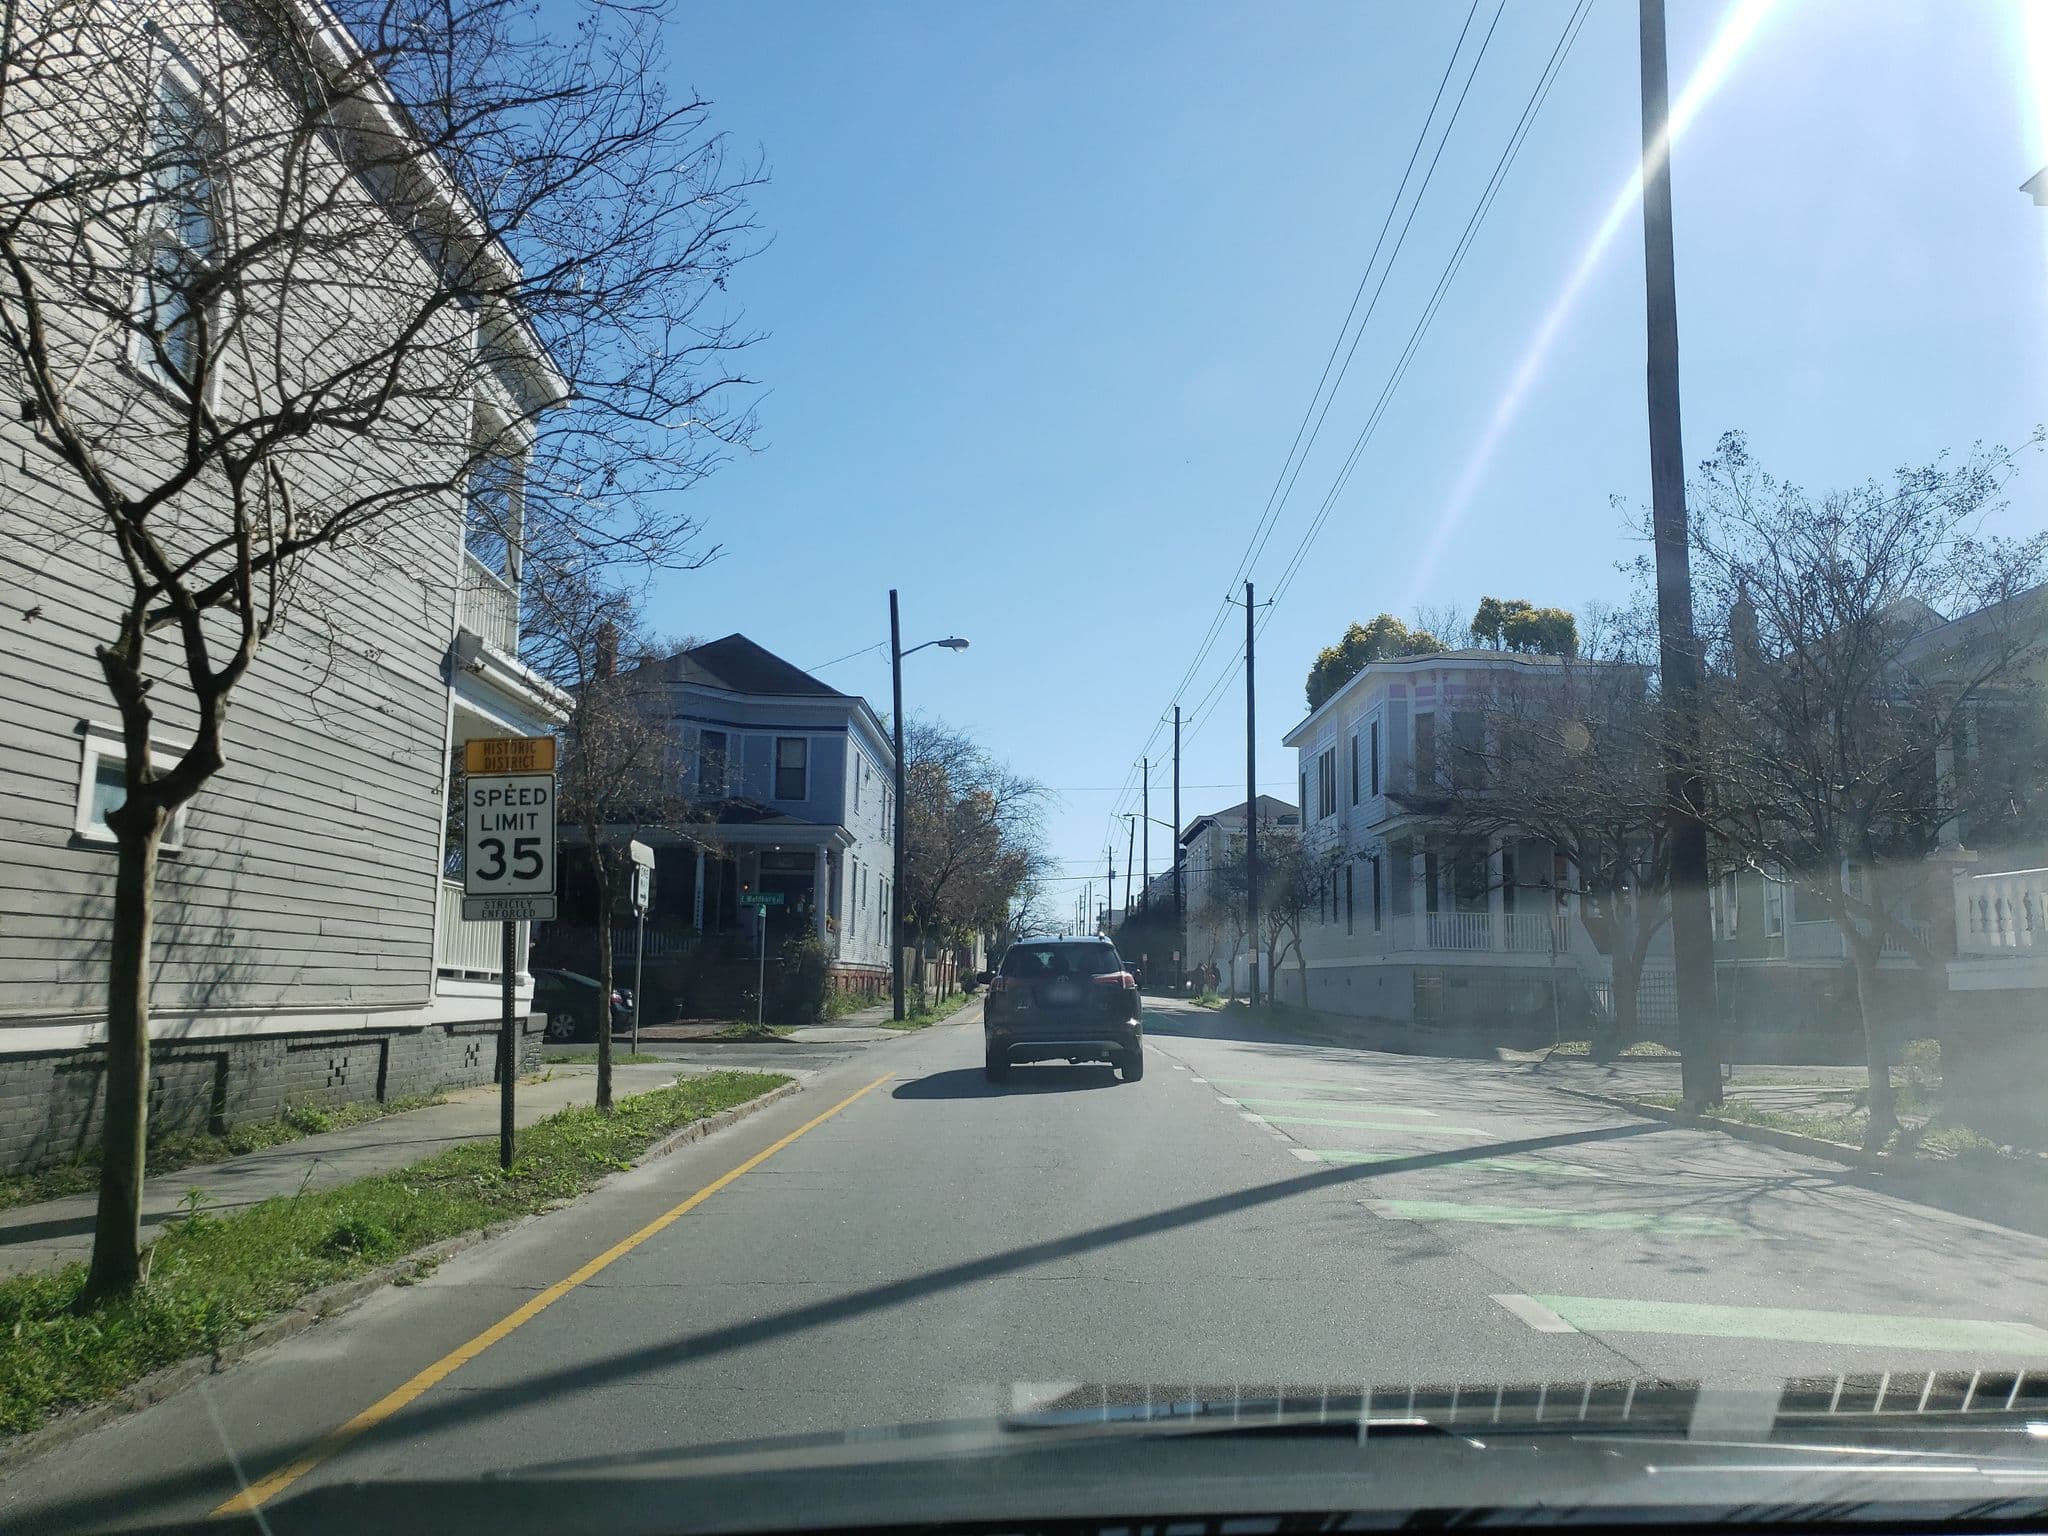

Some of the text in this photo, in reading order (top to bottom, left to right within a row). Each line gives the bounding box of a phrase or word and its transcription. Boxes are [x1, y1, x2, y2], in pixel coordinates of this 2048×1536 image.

[484, 741, 537, 755] HISTORIC
[484, 756, 535, 770] DISTRICT
[473, 788, 548, 807] SPEED
[481, 813, 539, 831] LIMIT
[475, 837, 544, 881] 35
[484, 900, 533, 910] STRICTLY
[482, 908, 536, 919] ENFORCED
